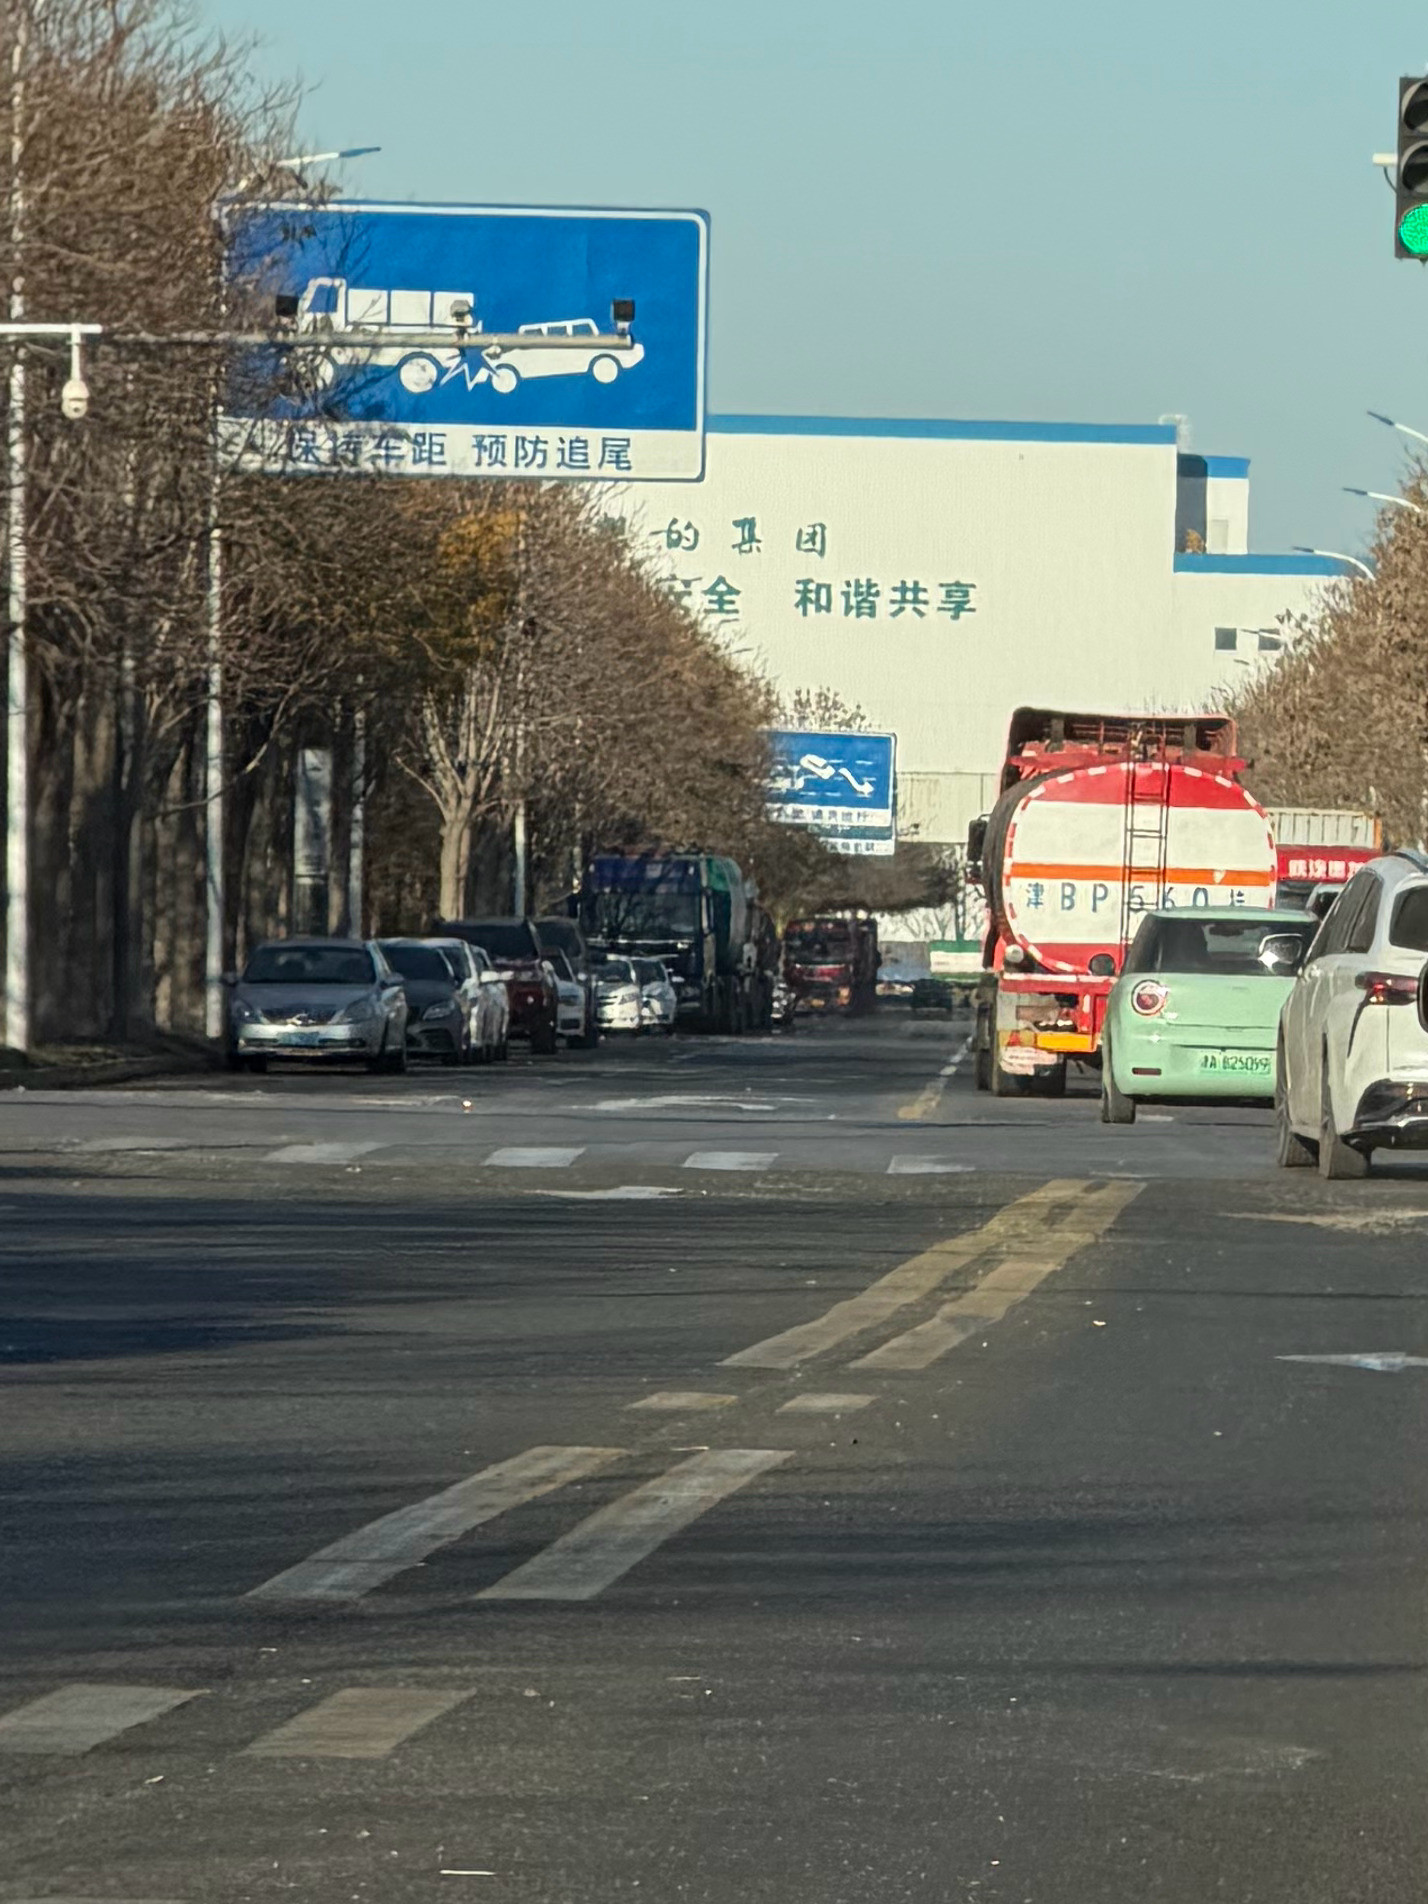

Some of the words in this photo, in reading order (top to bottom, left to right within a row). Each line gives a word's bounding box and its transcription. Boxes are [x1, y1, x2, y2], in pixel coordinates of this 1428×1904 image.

[471, 433, 633, 470] 预防追尾
[794, 577, 977, 621] 和谐共享
